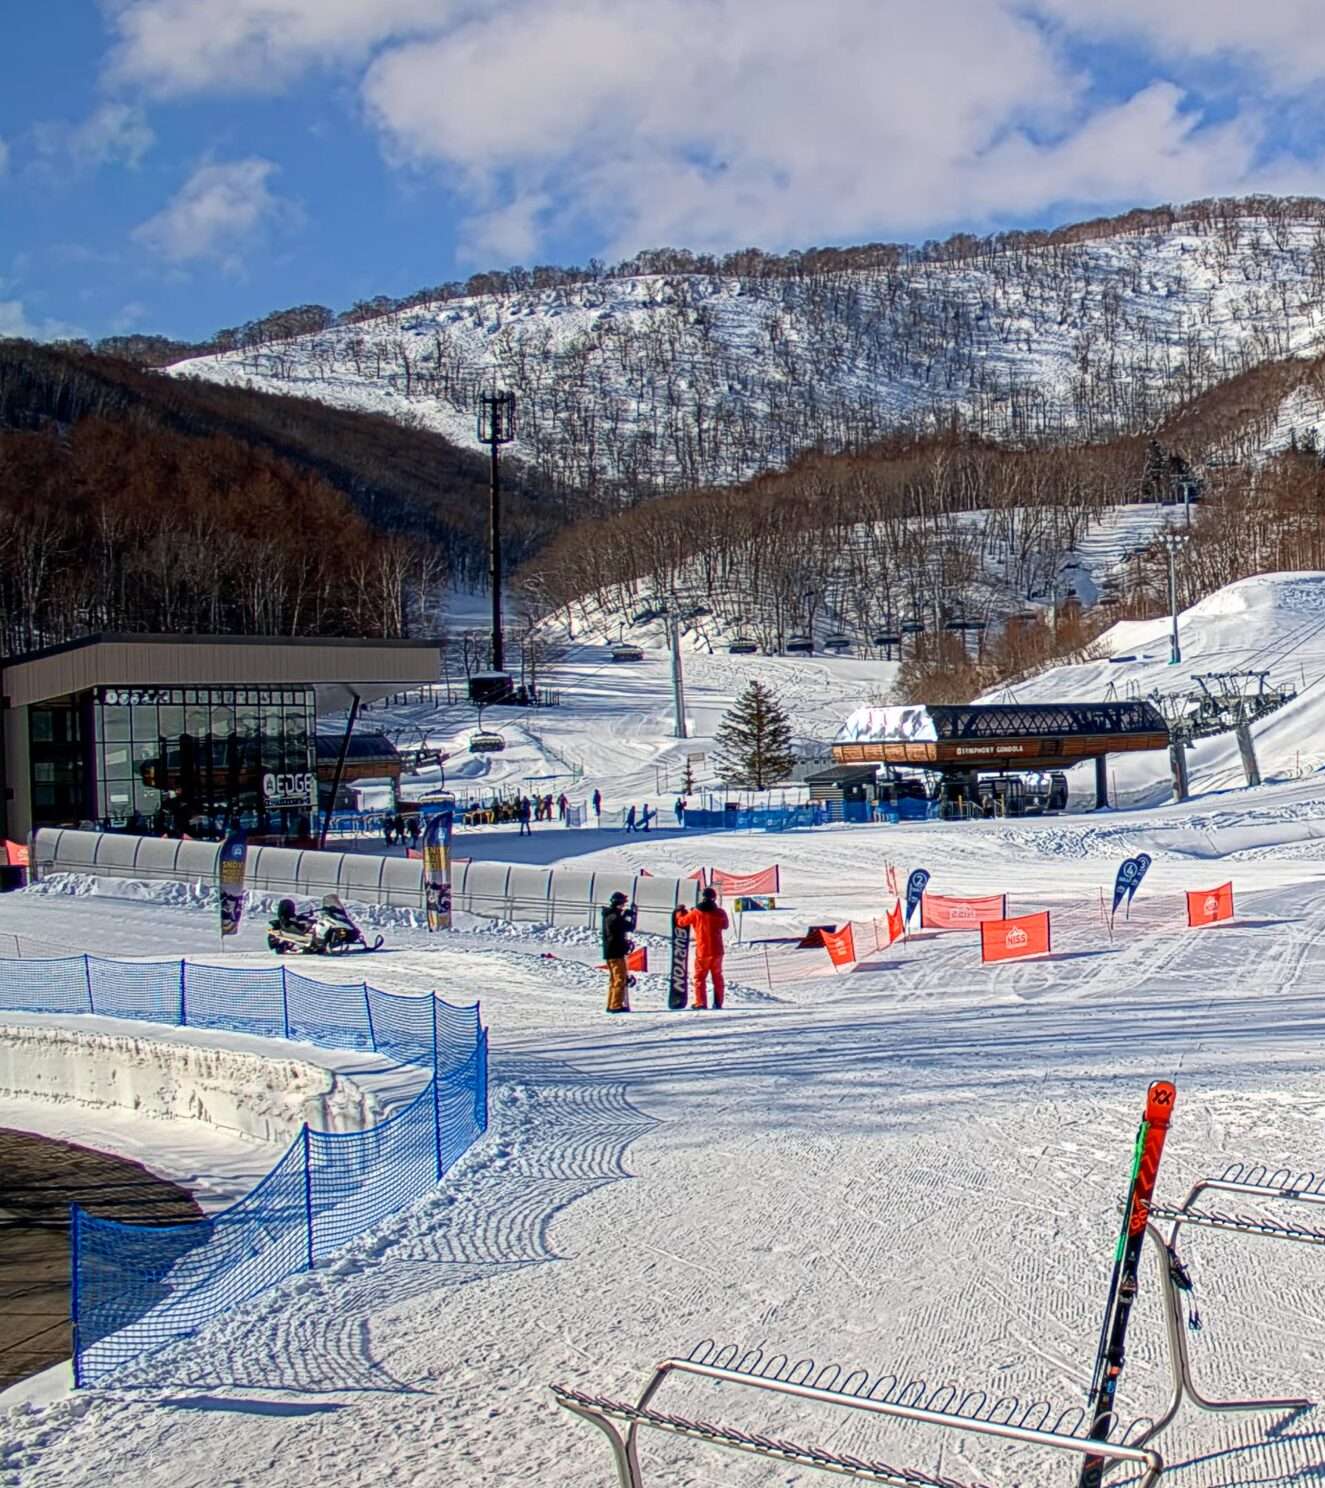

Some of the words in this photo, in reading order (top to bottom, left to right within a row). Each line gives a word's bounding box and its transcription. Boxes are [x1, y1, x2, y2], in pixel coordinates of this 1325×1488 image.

[277, 773, 312, 794] EDGE
[1007, 934, 1026, 945] NISS
[673, 927, 688, 993] BURTON
